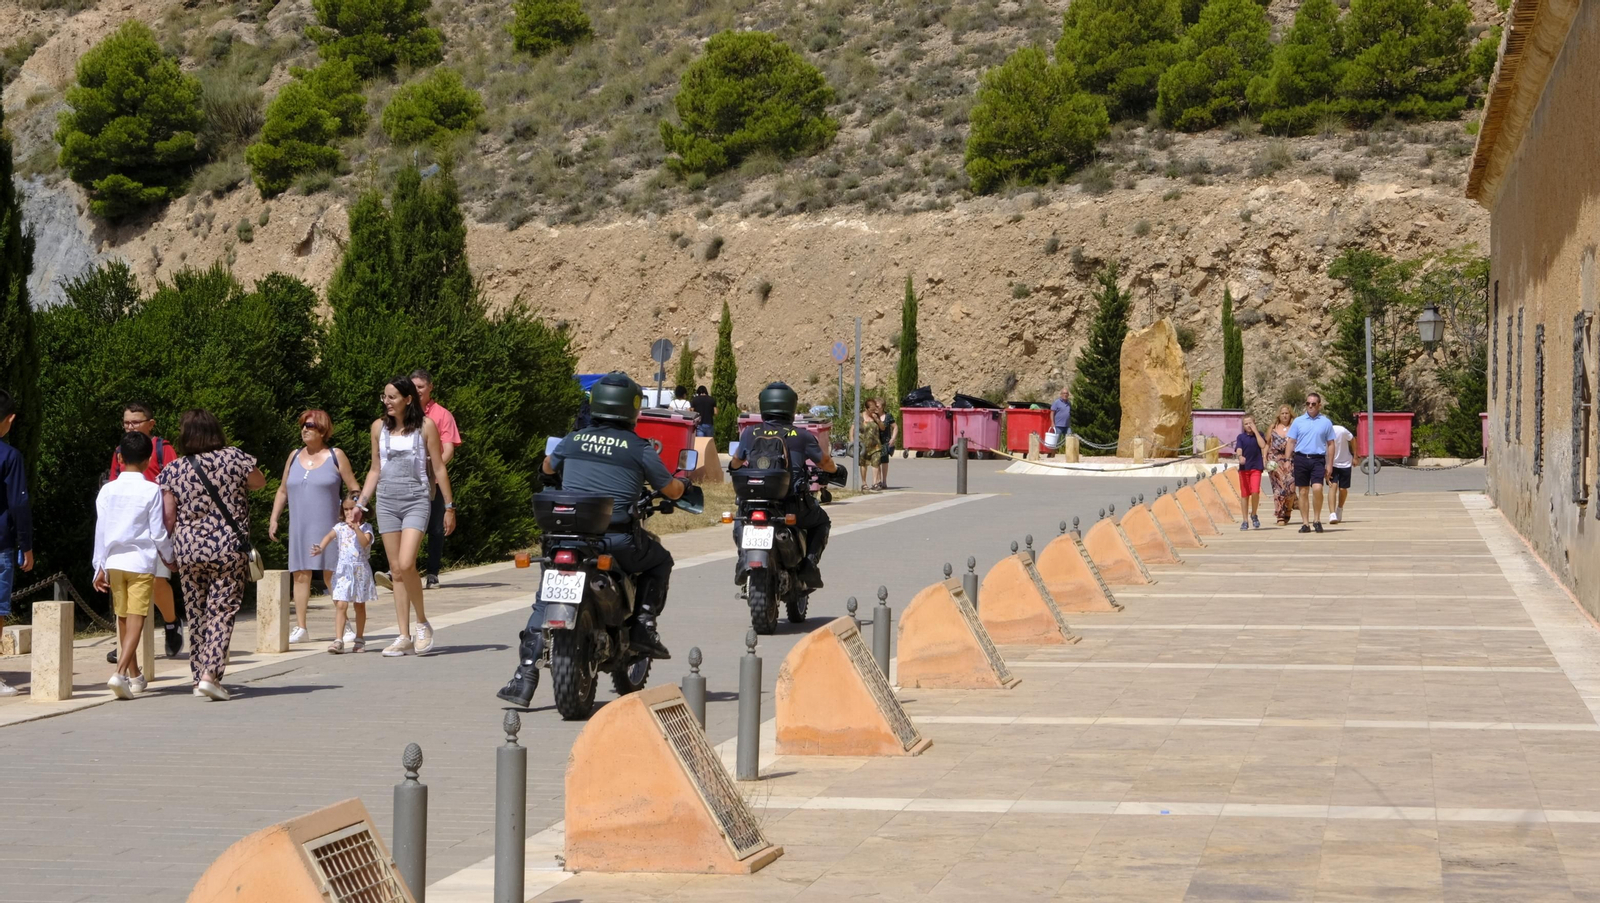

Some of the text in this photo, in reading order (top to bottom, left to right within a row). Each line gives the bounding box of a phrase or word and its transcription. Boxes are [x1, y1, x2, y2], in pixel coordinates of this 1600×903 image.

[573, 433, 629, 449] GUARDIA
[580, 442, 613, 456] CIVIL
[745, 538, 769, 548] 3336
[546, 572, 583, 588] PGC-X
[545, 586, 578, 601] 3335
